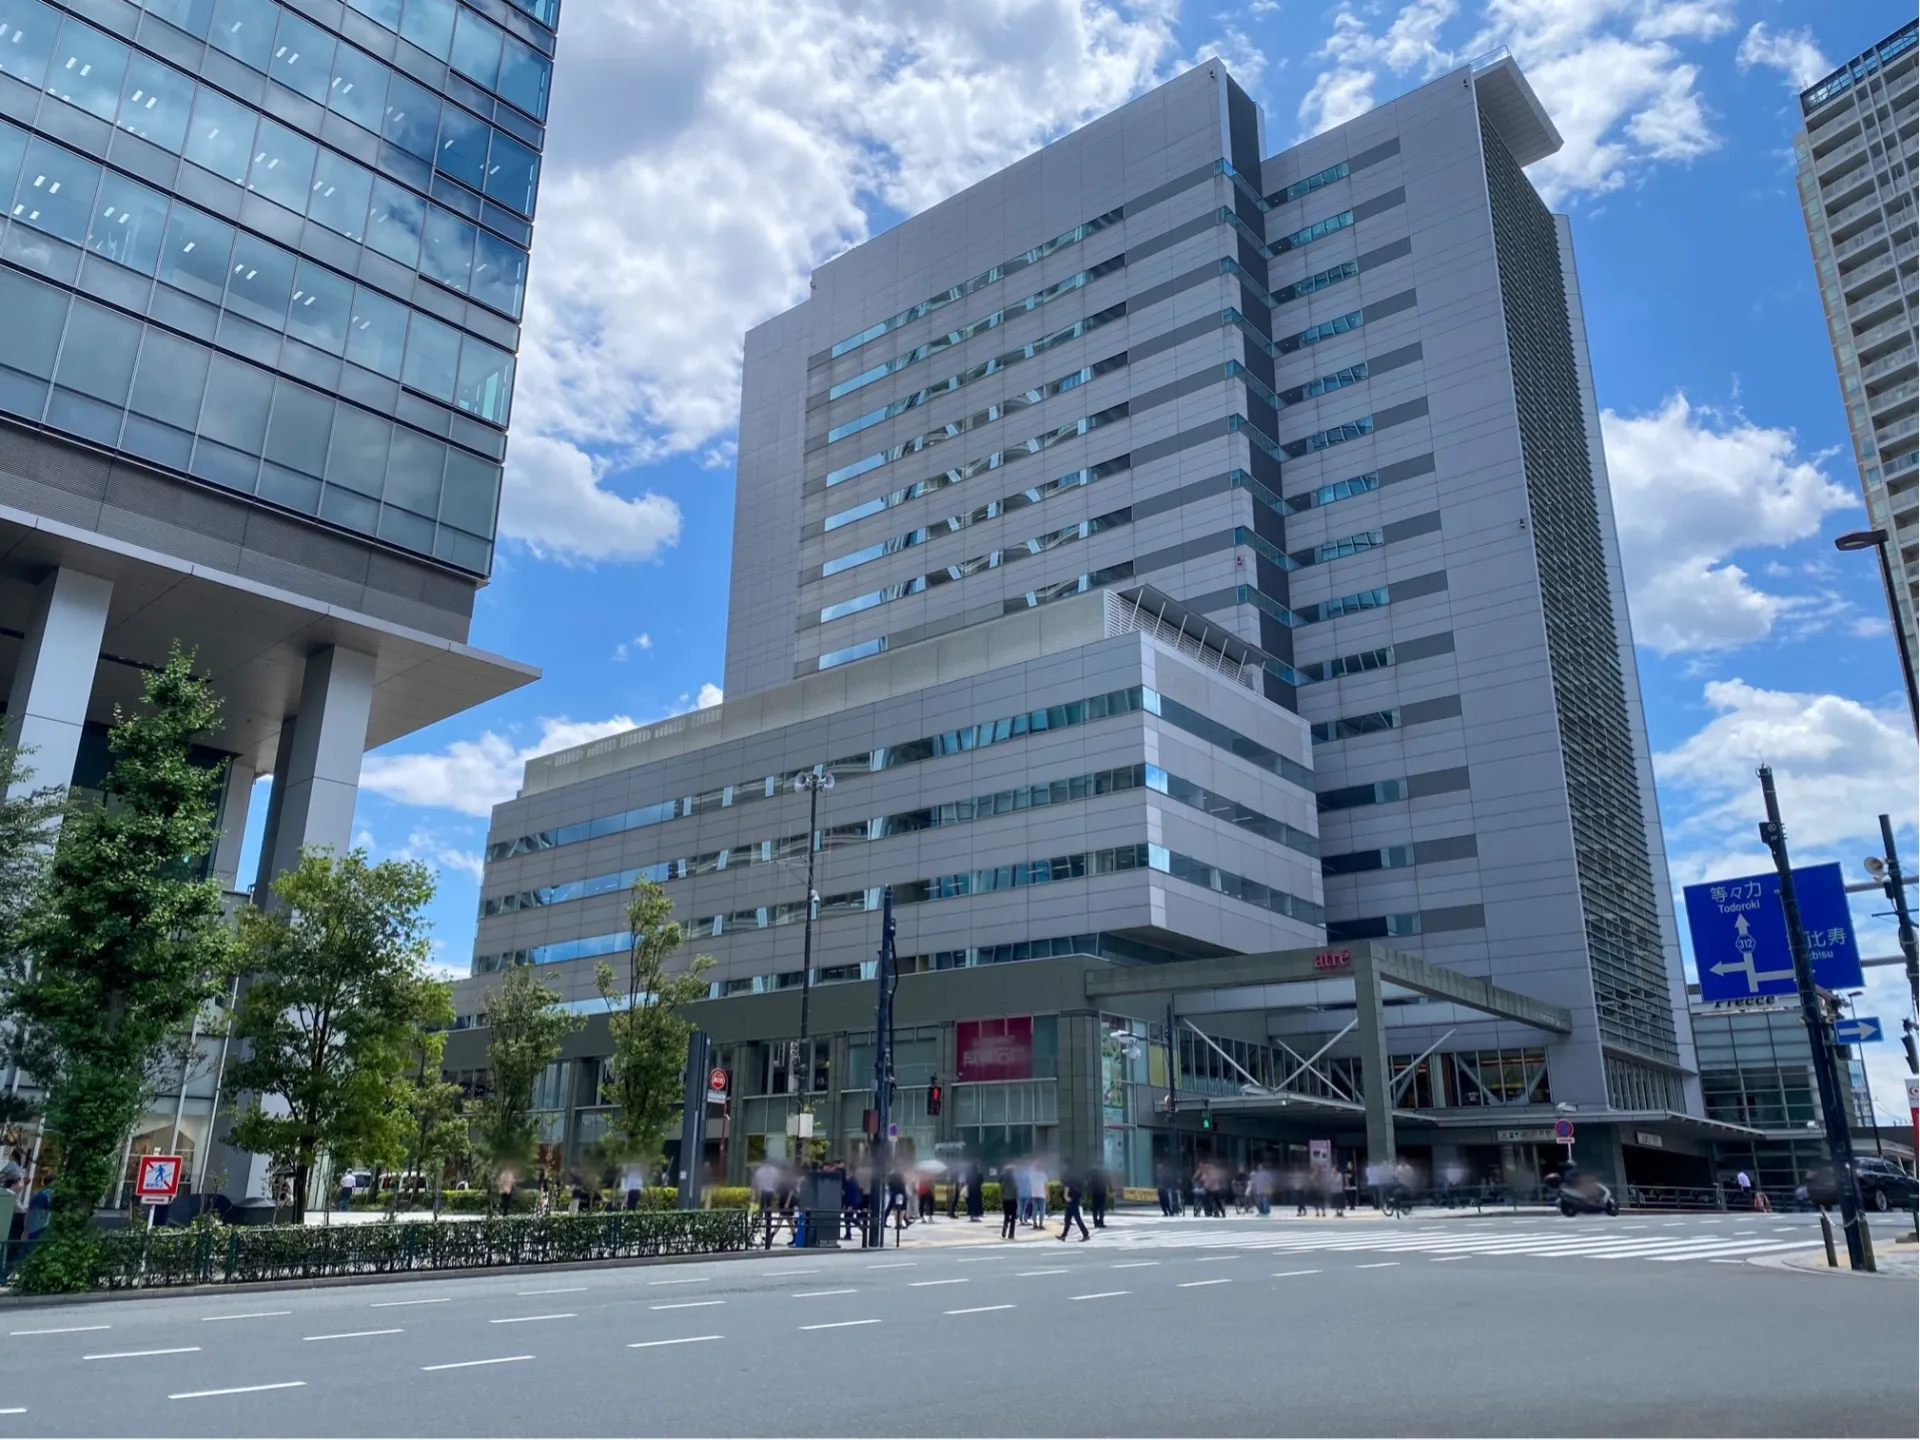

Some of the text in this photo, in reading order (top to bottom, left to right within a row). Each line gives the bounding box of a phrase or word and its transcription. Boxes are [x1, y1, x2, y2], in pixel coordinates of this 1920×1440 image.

[1710, 880, 1762, 903] 等々力
[1718, 900, 1760, 914] Todoroki
[1738, 938, 1753, 950] 312
[1788, 927, 1847, 949] 比寿
